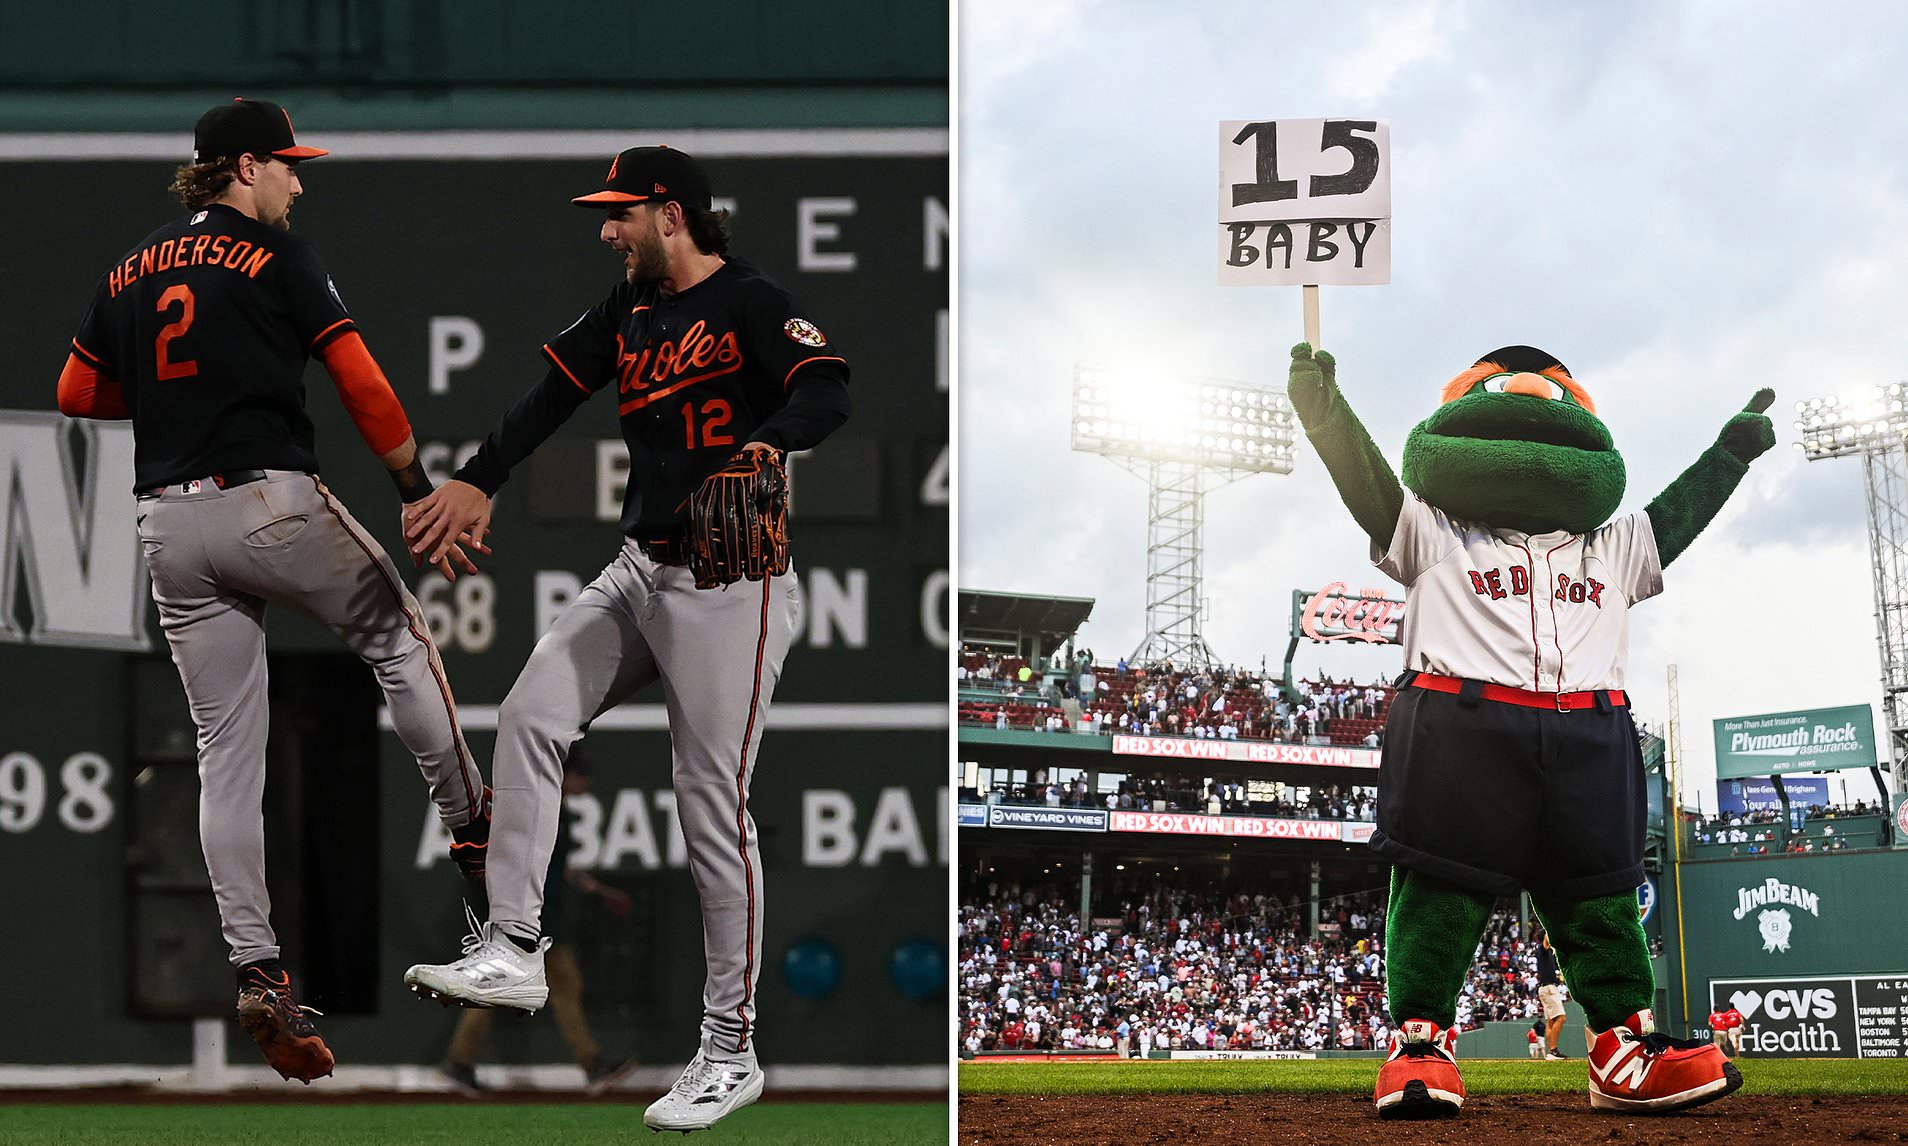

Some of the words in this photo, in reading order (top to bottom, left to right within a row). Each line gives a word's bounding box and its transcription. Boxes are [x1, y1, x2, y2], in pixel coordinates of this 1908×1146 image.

[1231, 119, 1380, 207] 15
[1226, 221, 1377, 269] BABY
[108, 235, 275, 299] HENDERSON
[155, 283, 198, 381] 2
[428, 315, 485, 396] P
[681, 399, 735, 450] 12
[1467, 565, 1529, 600] RED
[1555, 573, 1605, 609] SOX
[415, 570, 497, 654] 68
[1302, 582, 1396, 643] Coca
[1725, 722, 1742, 731] More
[1743, 720, 1760, 729] Than
[1760, 719, 1774, 728] Just
[1731, 726, 1809, 752] Plymouth
[1813, 722, 1857, 745] Rock
[1119, 738, 1151, 755] RED
[1152, 739, 1187, 756] SOX
[1190, 741, 1226, 758] WIN
[1249, 744, 1280, 761] RED
[1281, 746, 1314, 763] SOX
[1315, 748, 1351, 765] WIN
[803, 787, 948, 868] BA
[1004, 812, 1066, 824] VINEYARD
[1067, 815, 1103, 826] VINES
[1115, 813, 1147, 829] RED
[1150, 815, 1187, 831] SOX
[1189, 817, 1224, 833] WIN
[1234, 818, 1265, 835] RED
[1266, 820, 1301, 837] SOX
[1301, 822, 1338, 838] WIN
[1733, 886, 1767, 920] JIM
[1765, 878, 1818, 918] BEAM
[1764, 989, 1837, 1019] CVS
[1859, 1007, 1881, 1015] TAMPA
[1692, 1029, 1710, 1040] 310
[1861, 1028, 1890, 1036] BOSTON
[1877, 1017, 1896, 1025] YORK
[1738, 1023, 1841, 1052] Health
[1862, 1038, 1900, 1046] BALTIMORE
[1863, 1049, 1897, 1057] TORONTO
